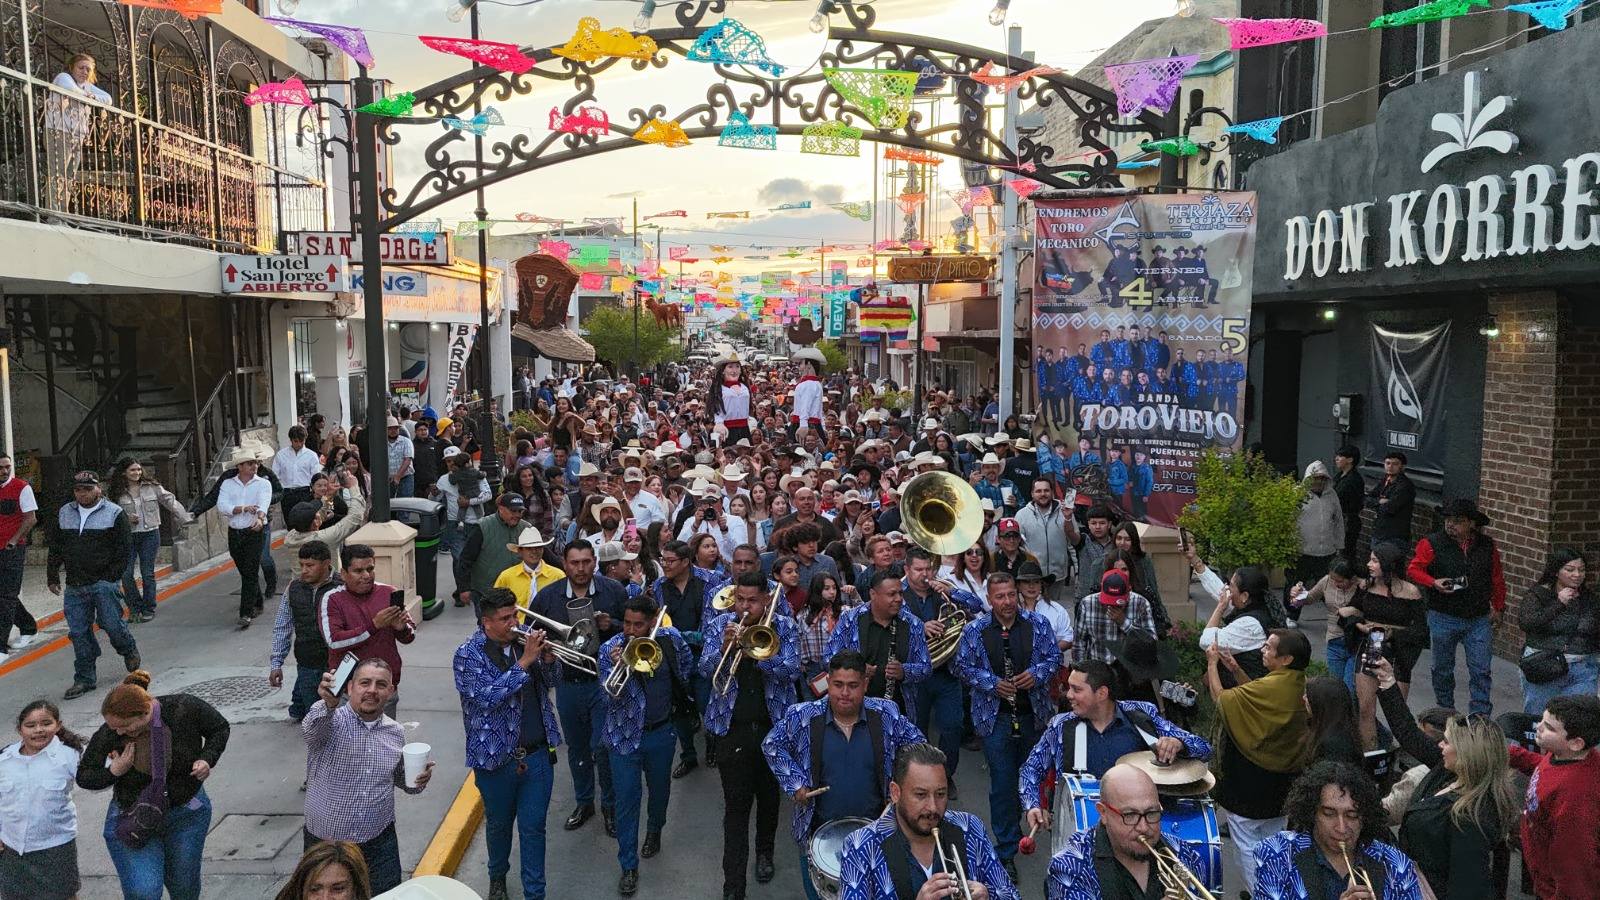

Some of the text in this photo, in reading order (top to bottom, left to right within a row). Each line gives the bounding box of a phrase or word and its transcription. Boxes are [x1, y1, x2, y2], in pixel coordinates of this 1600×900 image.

[1050, 223, 1084, 233] TORO
[1037, 238, 1099, 248] MECANICO
[1283, 201, 1374, 281] DON
[306, 236, 437, 260] SAN ORGE
[255, 257, 309, 270] Hotel
[1134, 267, 1205, 275] VIERNES
[241, 270, 325, 284] San Jorge
[241, 283, 329, 292] ABIERTO
[1119, 277, 1153, 306] 4
[1221, 319, 1247, 354] 5
[1138, 393, 1180, 404] BANDA
[1150, 448, 1187, 457] PUERTAS
[1149, 459, 1176, 467] DESDE
[1152, 484, 1174, 492] 877
